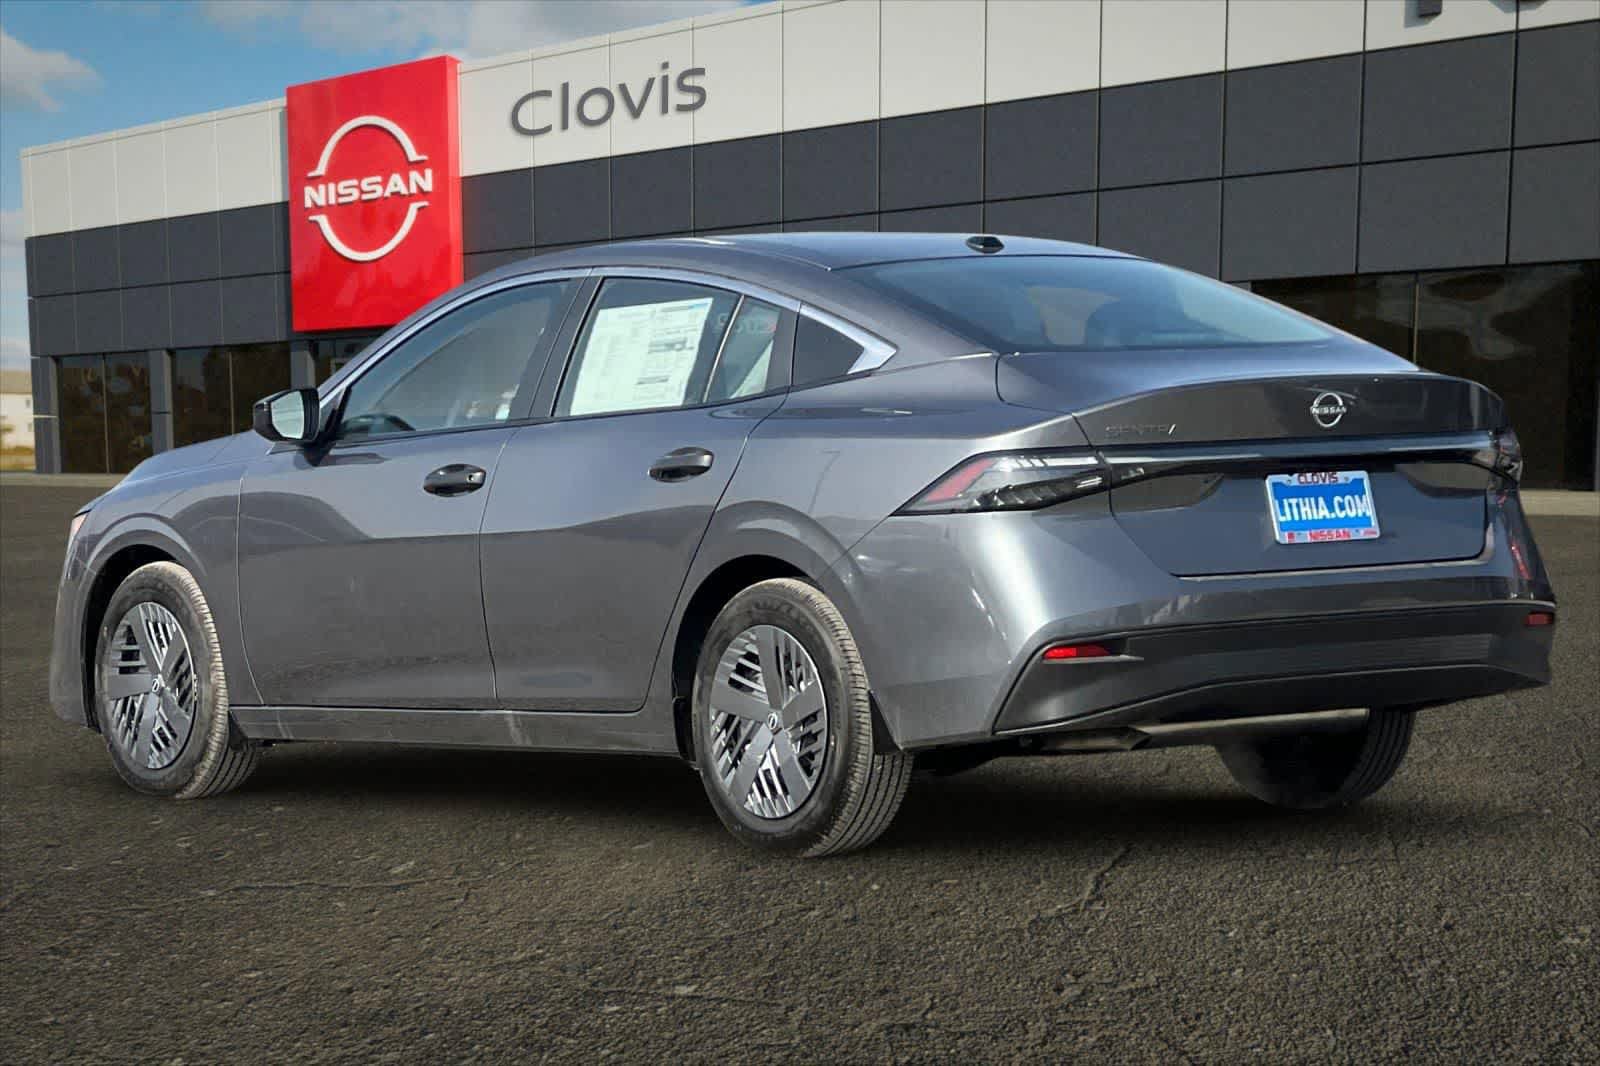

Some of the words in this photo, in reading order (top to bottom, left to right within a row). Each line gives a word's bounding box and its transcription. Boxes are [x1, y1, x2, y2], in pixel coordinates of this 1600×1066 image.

[510, 62, 707, 136] Clovis
[303, 169, 433, 208] NISSAN
[1310, 405, 1347, 415] NISSAN
[1298, 472, 1338, 485] CLOVIS
[1275, 495, 1372, 522] LITHIA.COM
[1309, 528, 1351, 541] NISSAN
